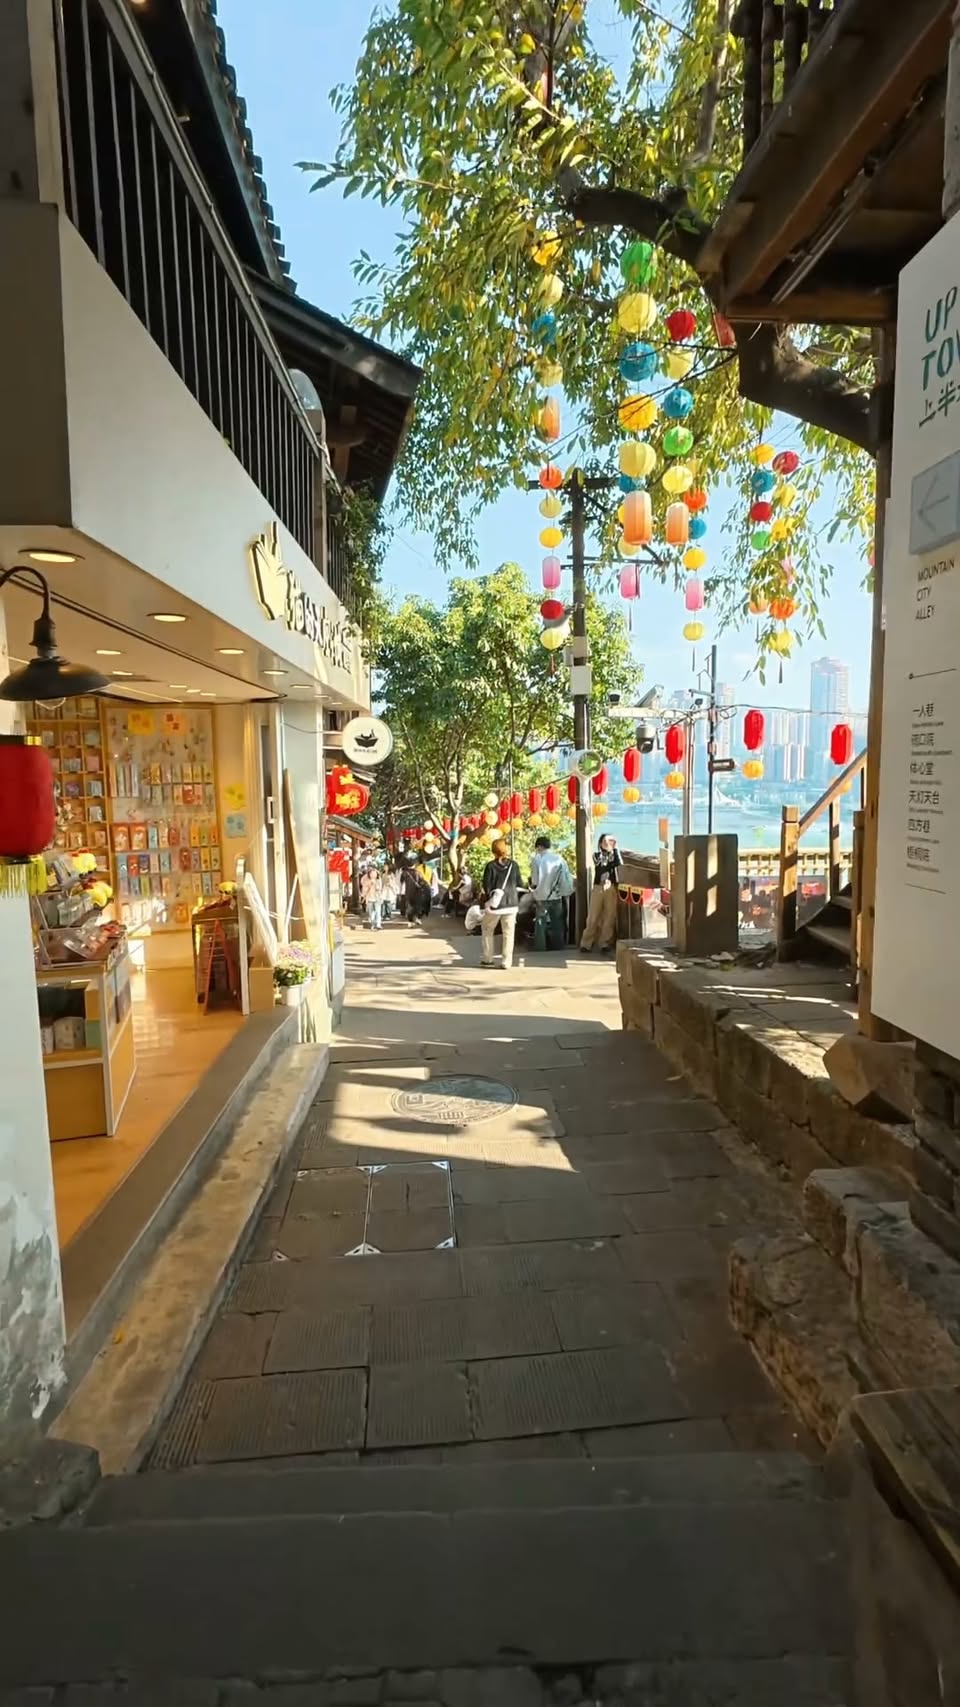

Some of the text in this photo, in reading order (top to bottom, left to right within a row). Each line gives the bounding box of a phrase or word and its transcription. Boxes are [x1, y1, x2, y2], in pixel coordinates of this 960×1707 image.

[925, 286, 958, 343] UP
[922, 329, 960, 391] TO
[919, 380, 960, 428] 上半
[918, 559, 955, 582] MOUNTAIN
[916, 586, 932, 602] CITY
[915, 604, 935, 620] ALLEY
[911, 703, 934, 718] 一人巷
[908, 790, 940, 805] 天灯天台
